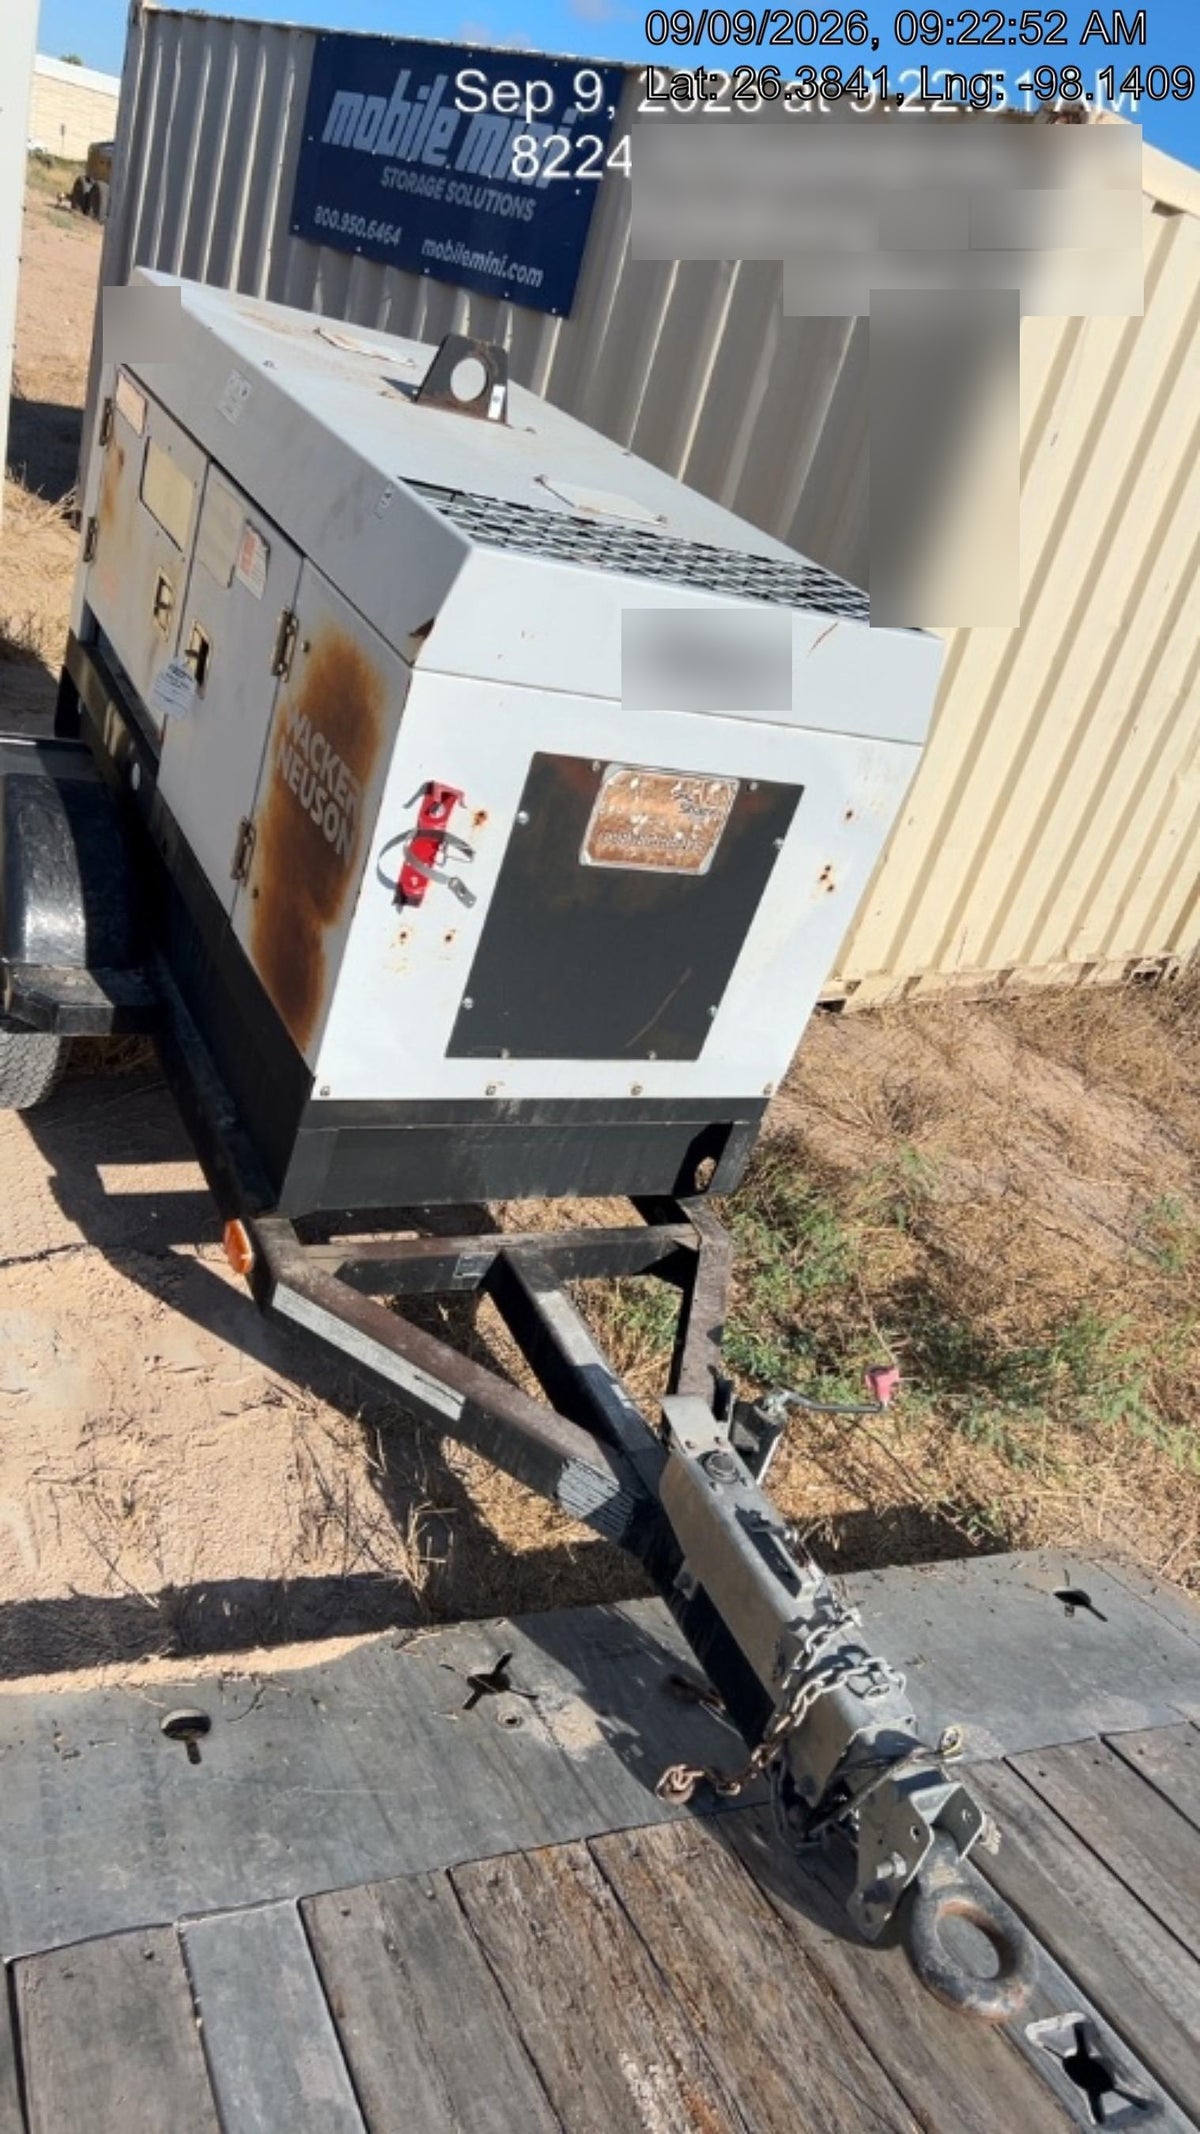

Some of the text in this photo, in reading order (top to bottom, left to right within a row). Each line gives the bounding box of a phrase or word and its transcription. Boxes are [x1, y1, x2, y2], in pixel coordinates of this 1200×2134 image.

[321, 69, 580, 189] mobile mini
[381, 166, 536, 222] STORAGE SOLUTIONS
[313, 205, 544, 288] 800.950.6464 mobilemini.com
[279, 735, 355, 867] NEUSON
